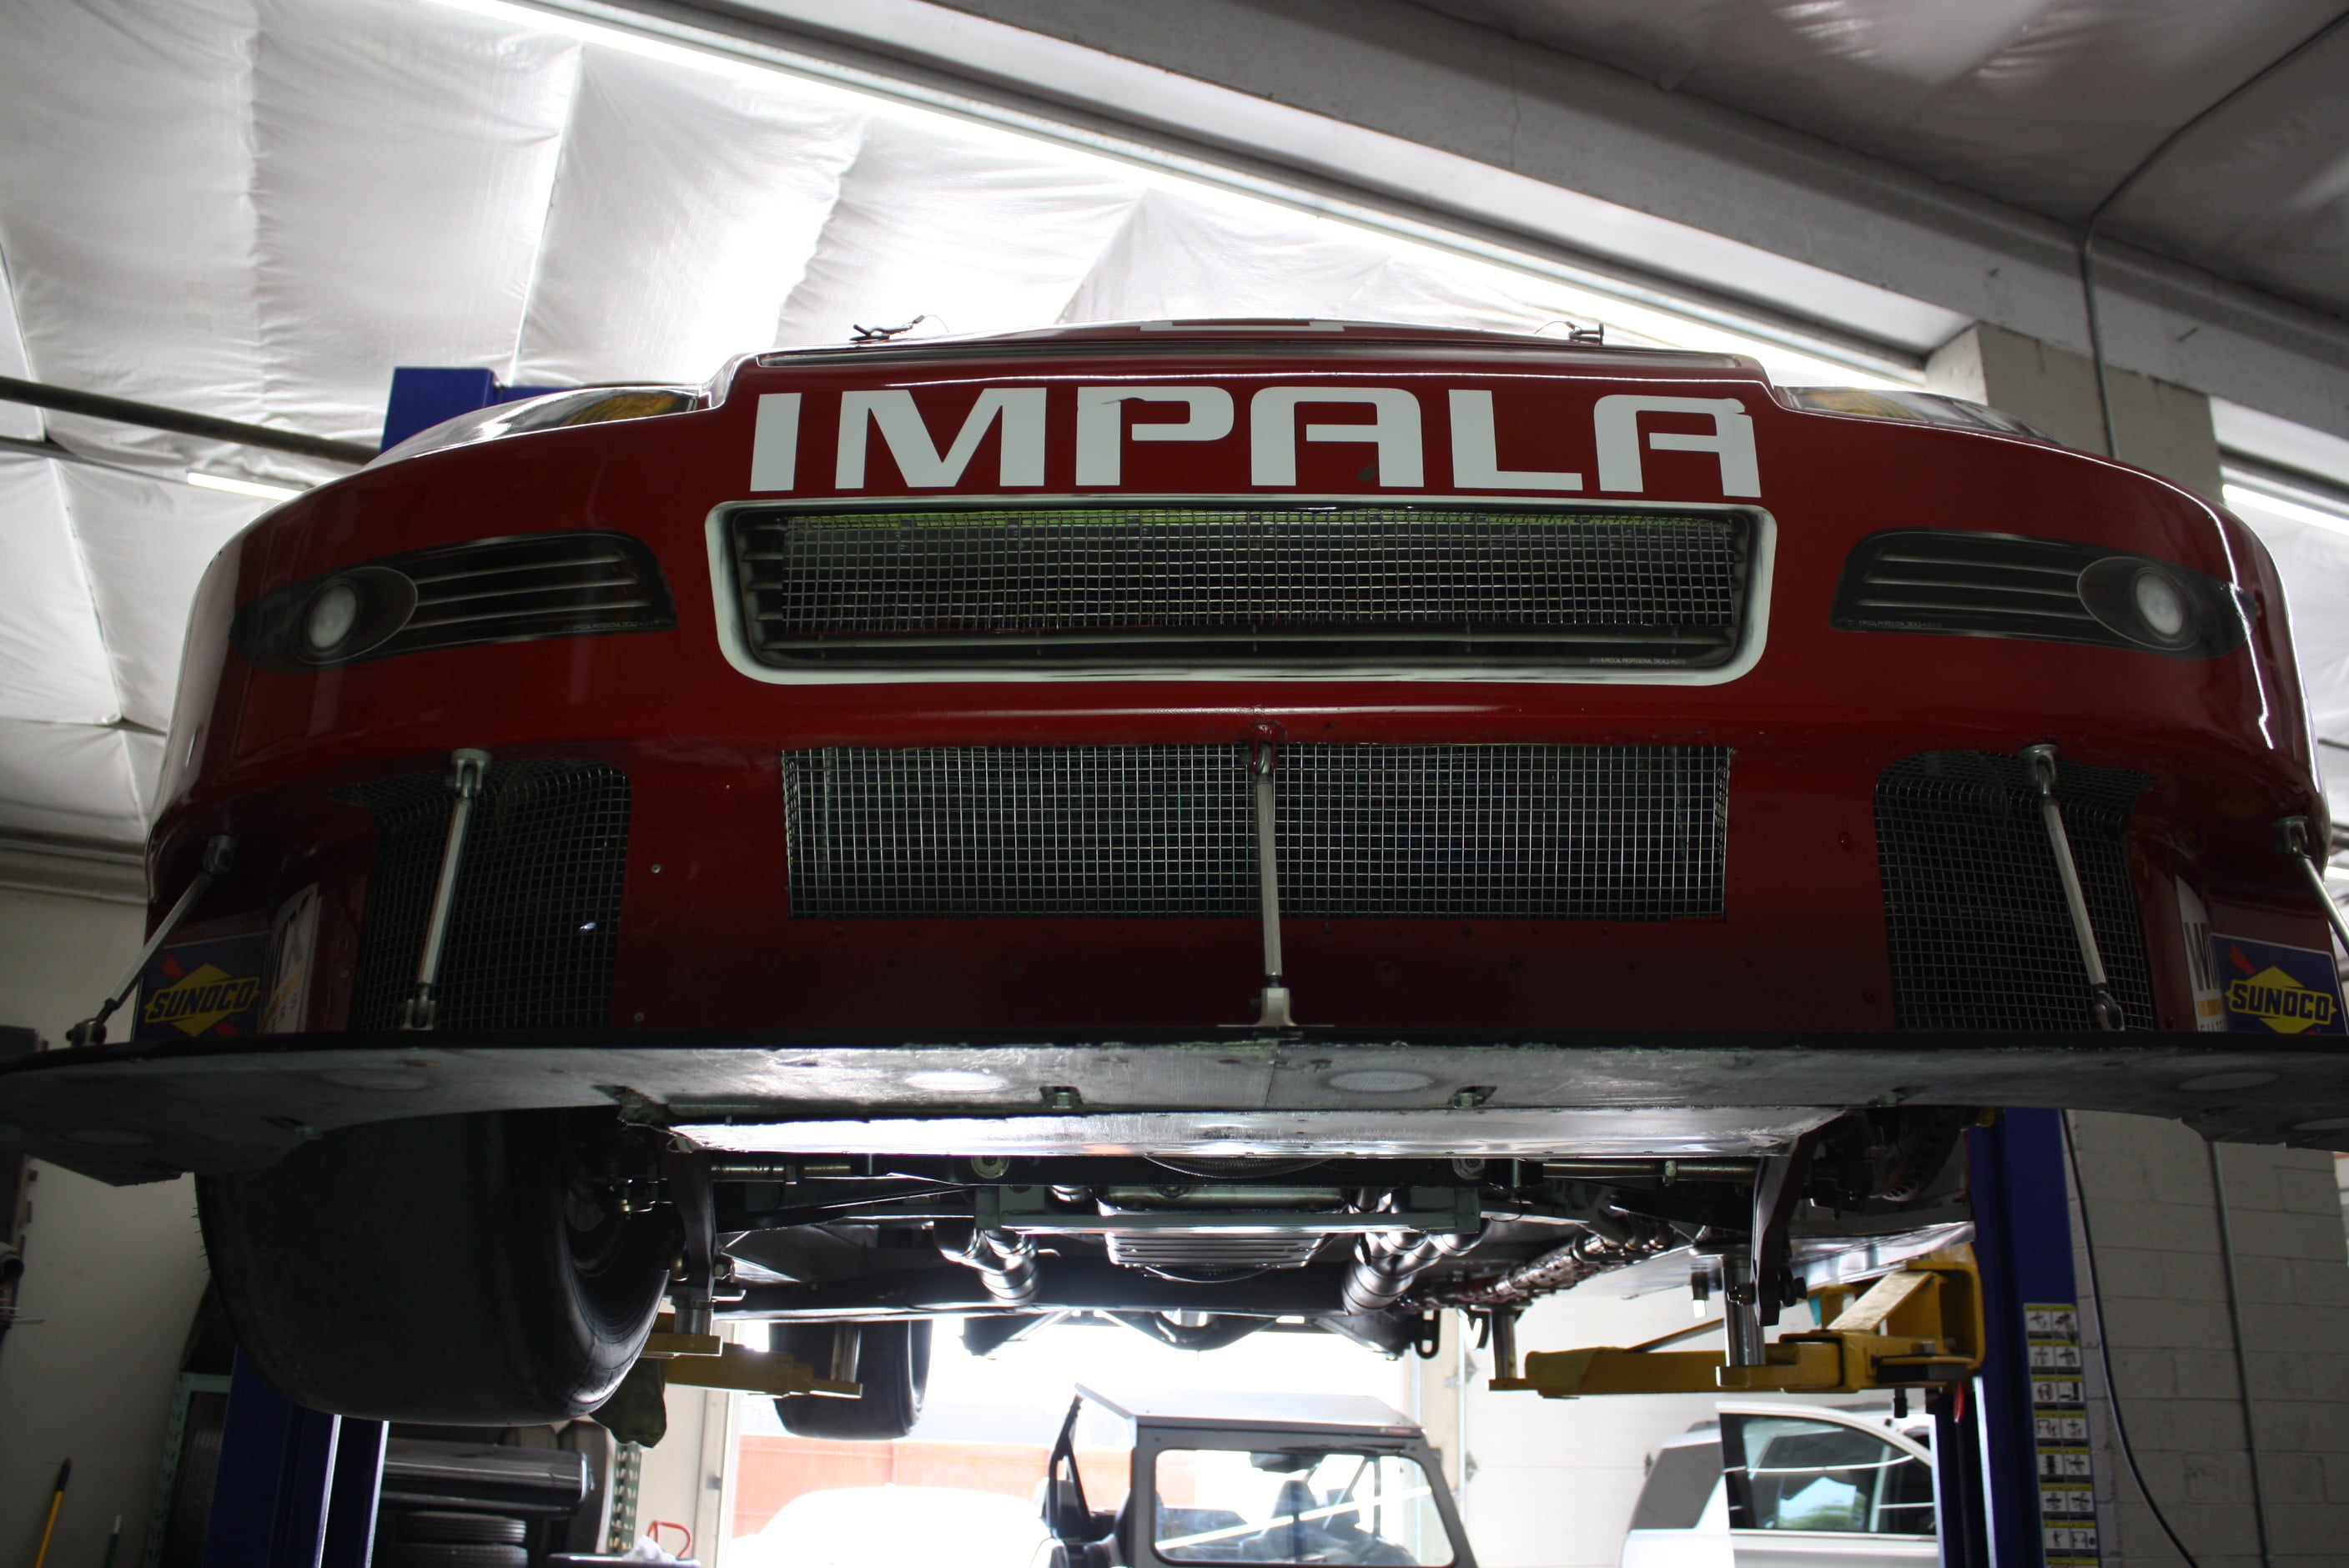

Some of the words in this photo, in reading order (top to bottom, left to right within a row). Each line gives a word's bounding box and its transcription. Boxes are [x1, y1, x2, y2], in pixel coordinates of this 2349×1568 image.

[750, 385, 1762, 499] IMPALA
[147, 982, 255, 1020] SUNOCO
[2231, 983, 2331, 1022] SUNOCO
